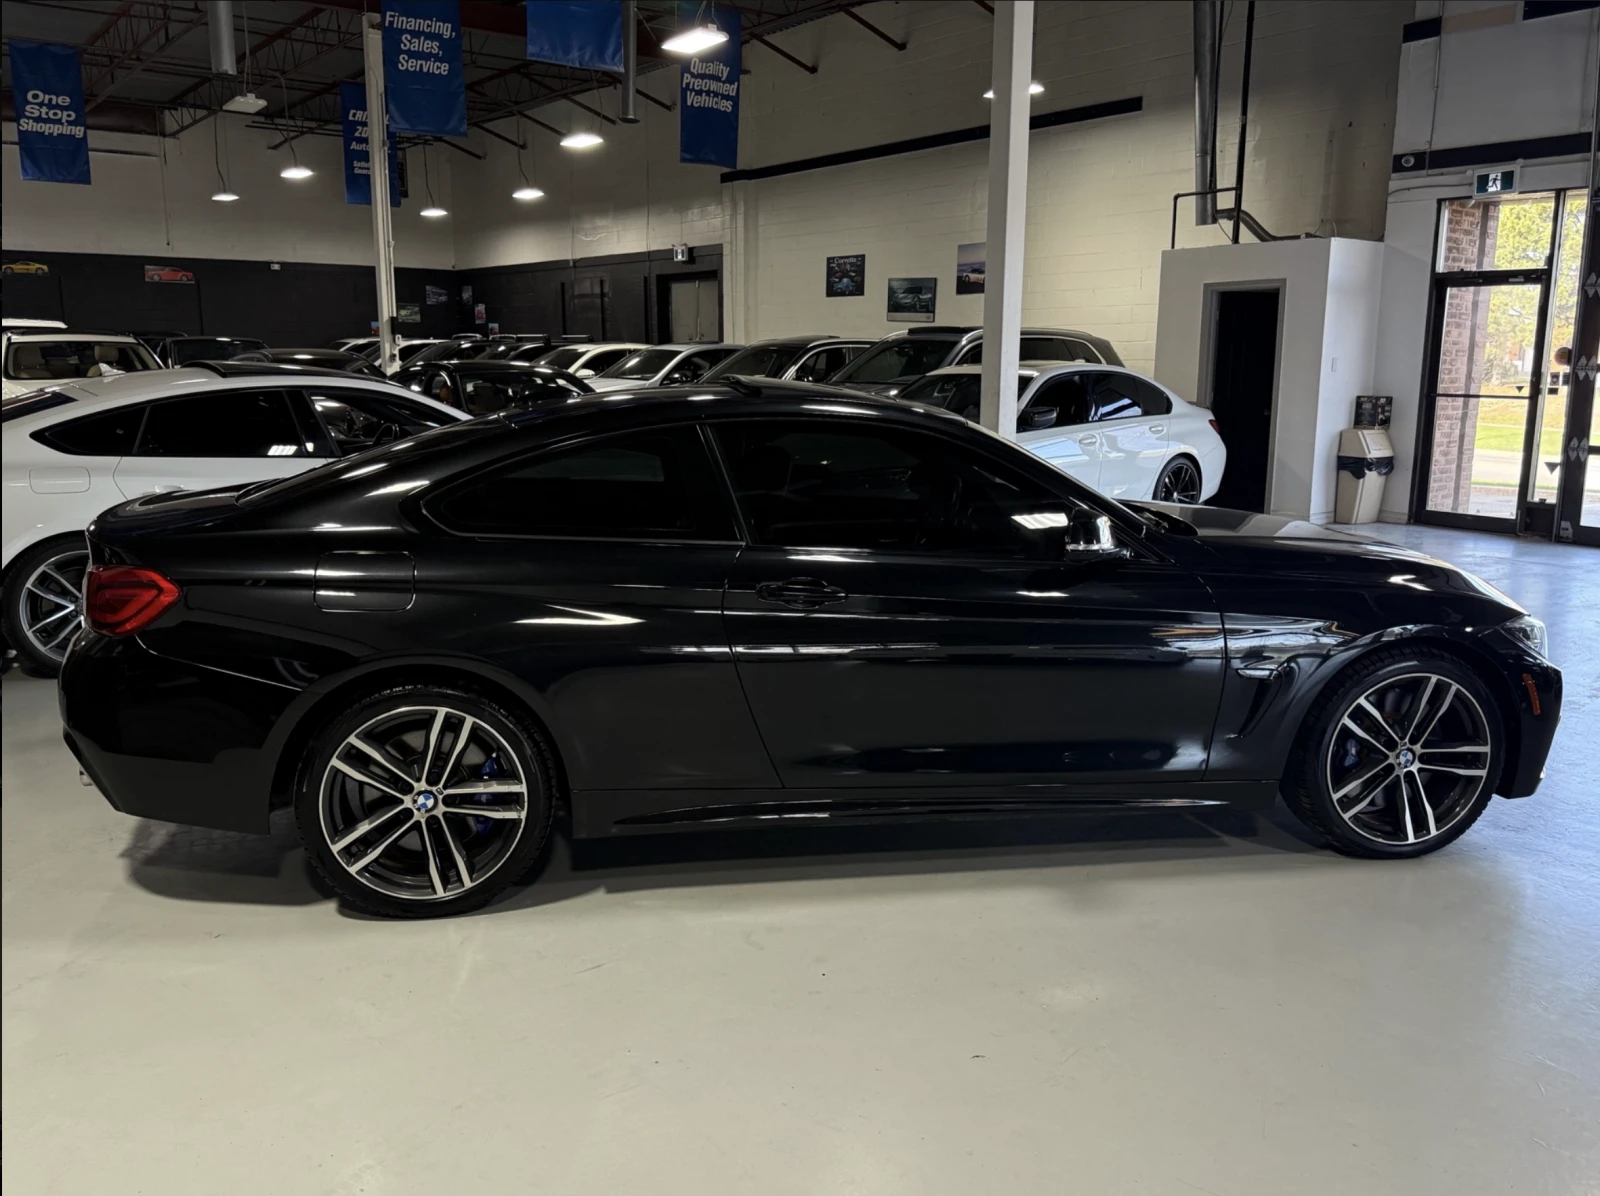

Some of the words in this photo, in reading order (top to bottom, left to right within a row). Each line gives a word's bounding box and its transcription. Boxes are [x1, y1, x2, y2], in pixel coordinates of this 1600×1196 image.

[385, 11, 456, 38] Financing,
[400, 34, 443, 57] Sales,
[398, 54, 449, 75] Service
[690, 57, 730, 81] Quality
[682, 73, 738, 96] Preowned
[26, 90, 71, 106] One
[686, 90, 733, 113] Vehicles
[24, 104, 76, 123] Stop
[19, 118, 85, 138] Shopping
